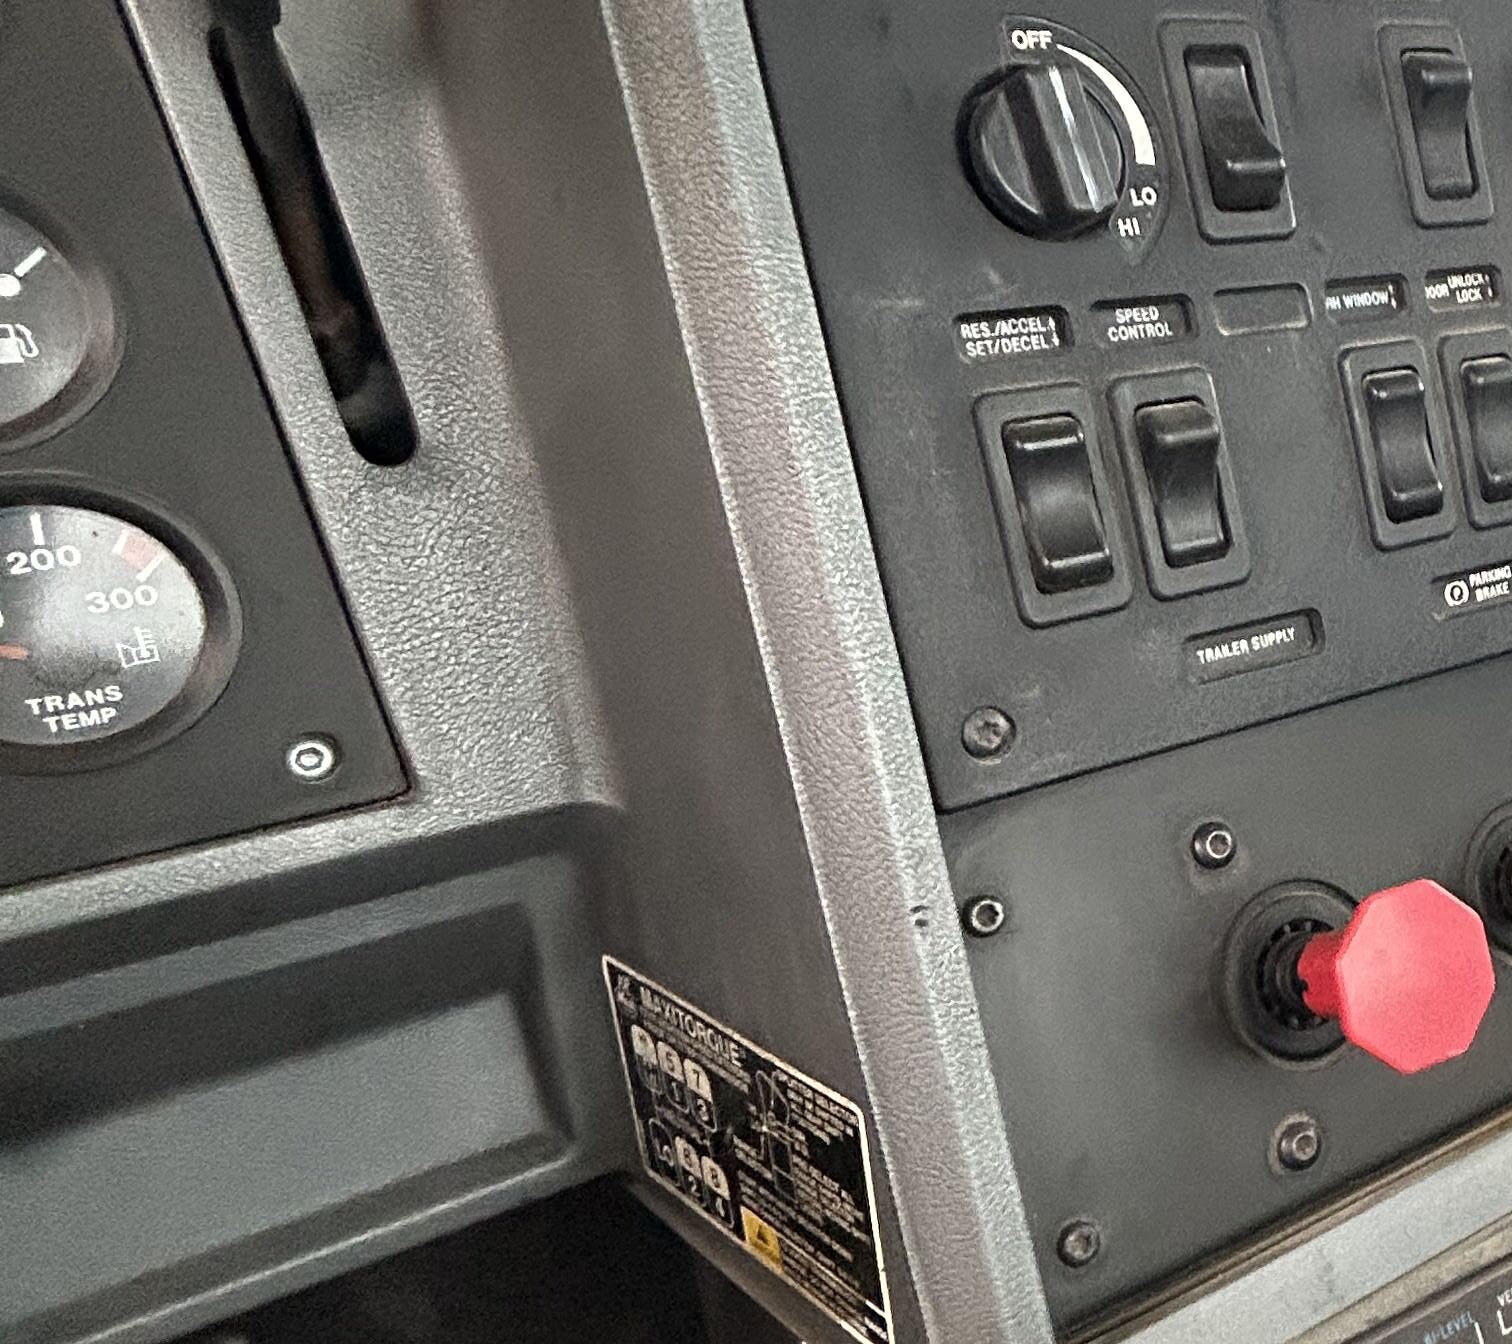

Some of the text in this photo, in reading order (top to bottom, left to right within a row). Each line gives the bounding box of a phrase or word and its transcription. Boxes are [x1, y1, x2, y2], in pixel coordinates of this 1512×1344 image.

[1011, 30, 1052, 50] OFF
[1129, 186, 1157, 207] LO
[1117, 217, 1141, 237] HI
[1447, 273, 1485, 289] UNLOCK
[1343, 291, 1389, 309] WINDOW
[1456, 287, 1483, 304] LOCK
[1115, 306, 1160, 324] SPEED
[1107, 322, 1173, 342] CONTROL
[965, 336, 1050, 357] SET/DECEL
[7, 544, 81, 575] 200
[1469, 565, 1512, 588] PARKING
[85, 584, 158, 613] 300
[1475, 581, 1510, 602] BRAKE
[1196, 626, 1295, 664] TRAILER SUPPLY
[25, 685, 124, 715] TRANS
[43, 707, 117, 733] TEMP
